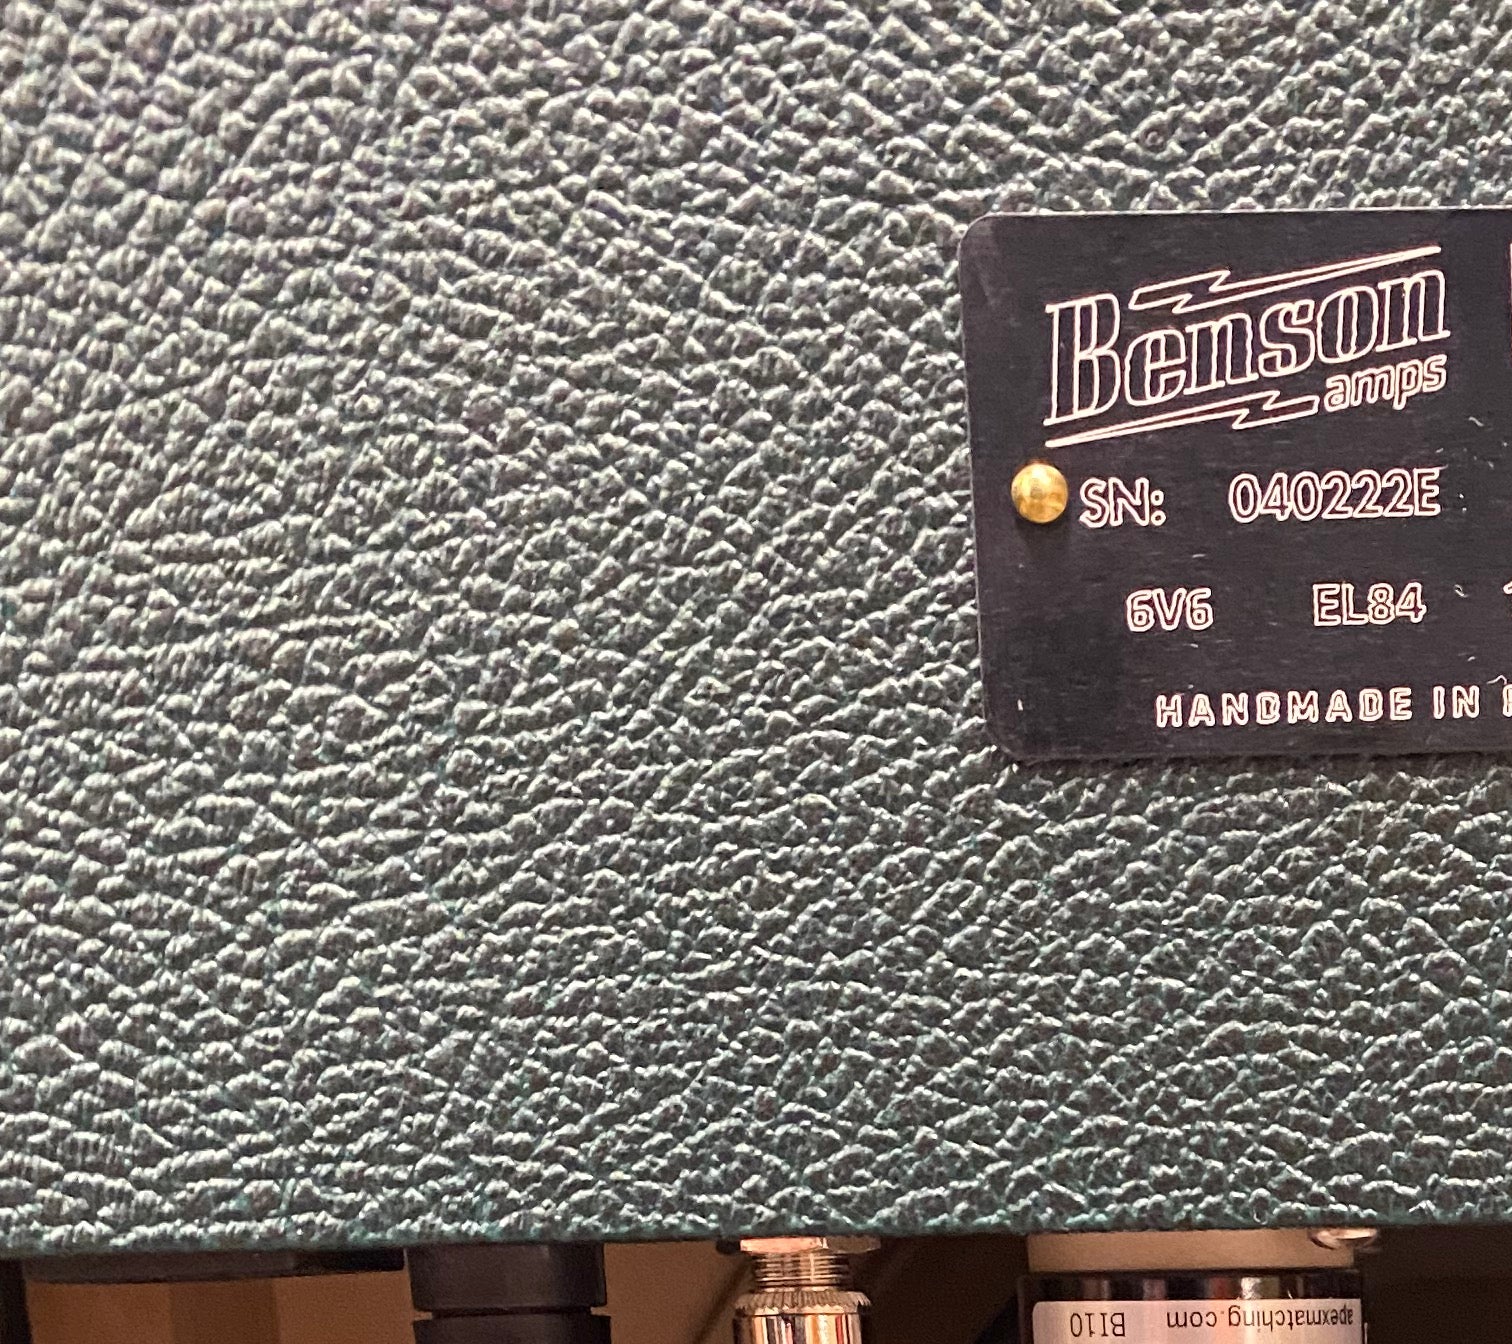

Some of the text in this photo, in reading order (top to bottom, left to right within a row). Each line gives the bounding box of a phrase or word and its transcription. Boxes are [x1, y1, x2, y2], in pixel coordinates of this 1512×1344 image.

[1043, 269, 1450, 426] Benson
[1322, 353, 1448, 410] amps
[1078, 466, 1442, 528] SN: 040222E
[1126, 587, 1214, 632] 6V6
[1312, 581, 1427, 627] EL84
[1155, 686, 1413, 728] HANDMADE
[1432, 685, 1480, 720] IN
[1166, 1305, 1354, 1328] apexmatching.com
